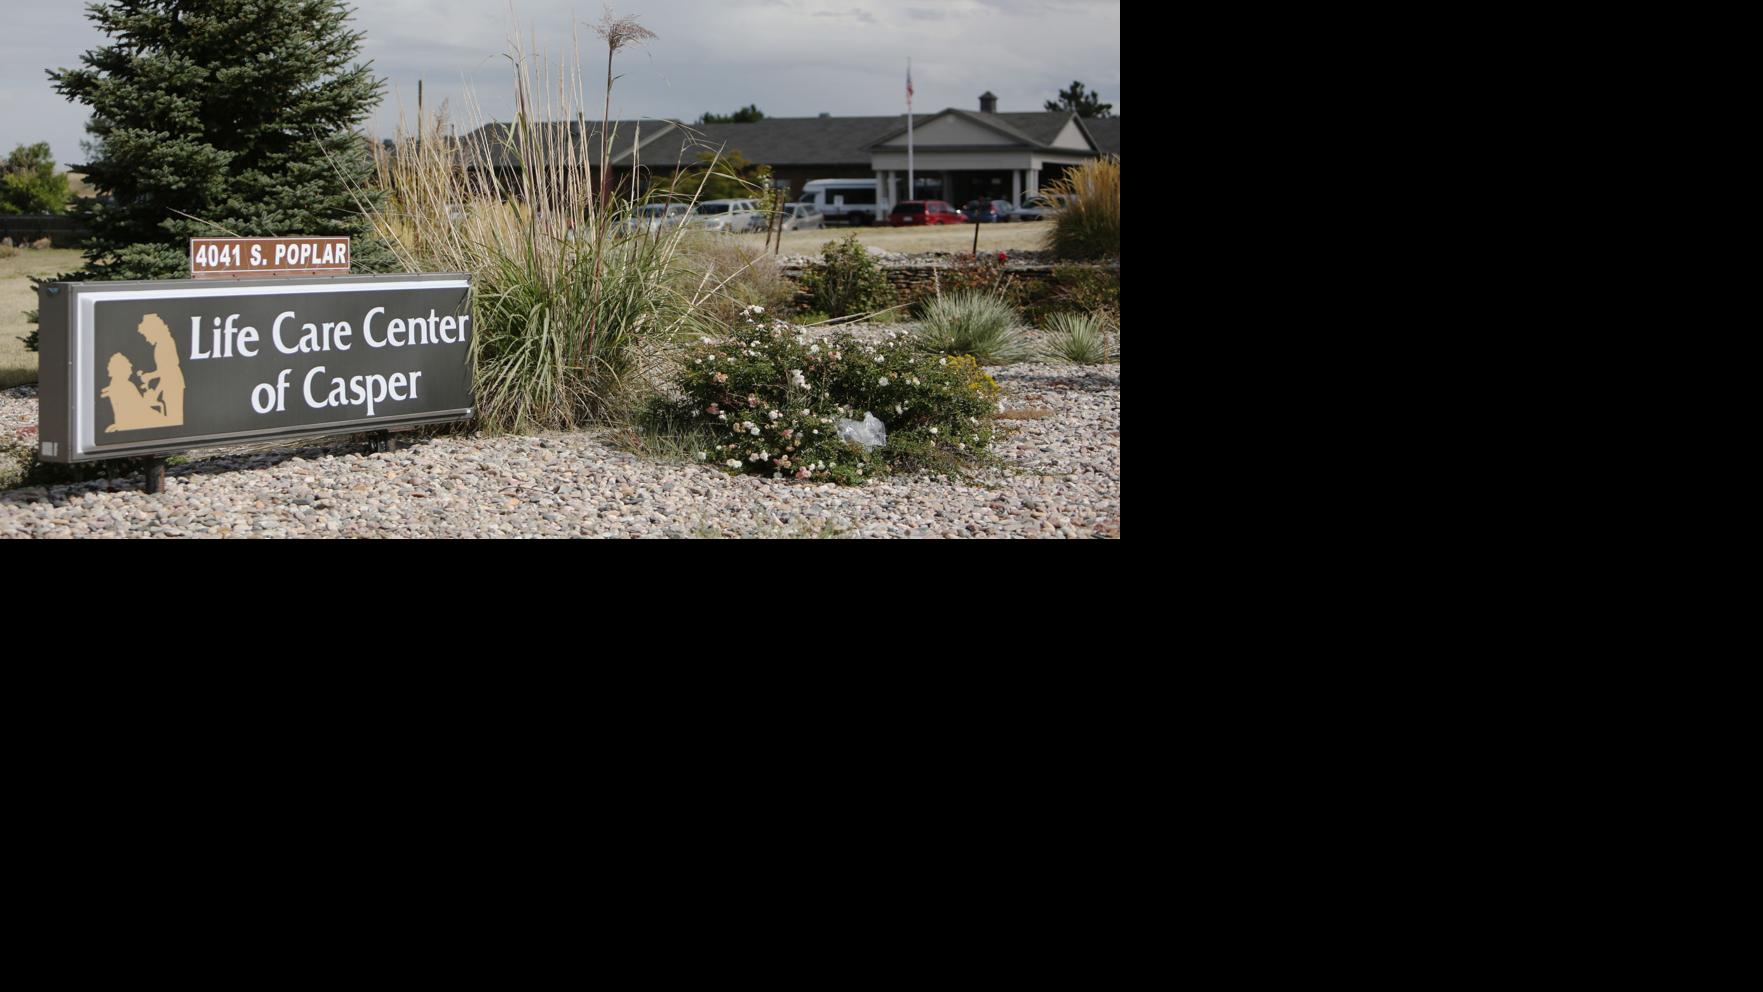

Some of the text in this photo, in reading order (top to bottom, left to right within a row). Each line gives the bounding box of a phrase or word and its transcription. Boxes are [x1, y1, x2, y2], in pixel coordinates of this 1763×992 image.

[195, 242, 347, 266] 4041 S. POPLAR
[189, 306, 469, 360] Life Care Center
[251, 366, 422, 416] of Casper
